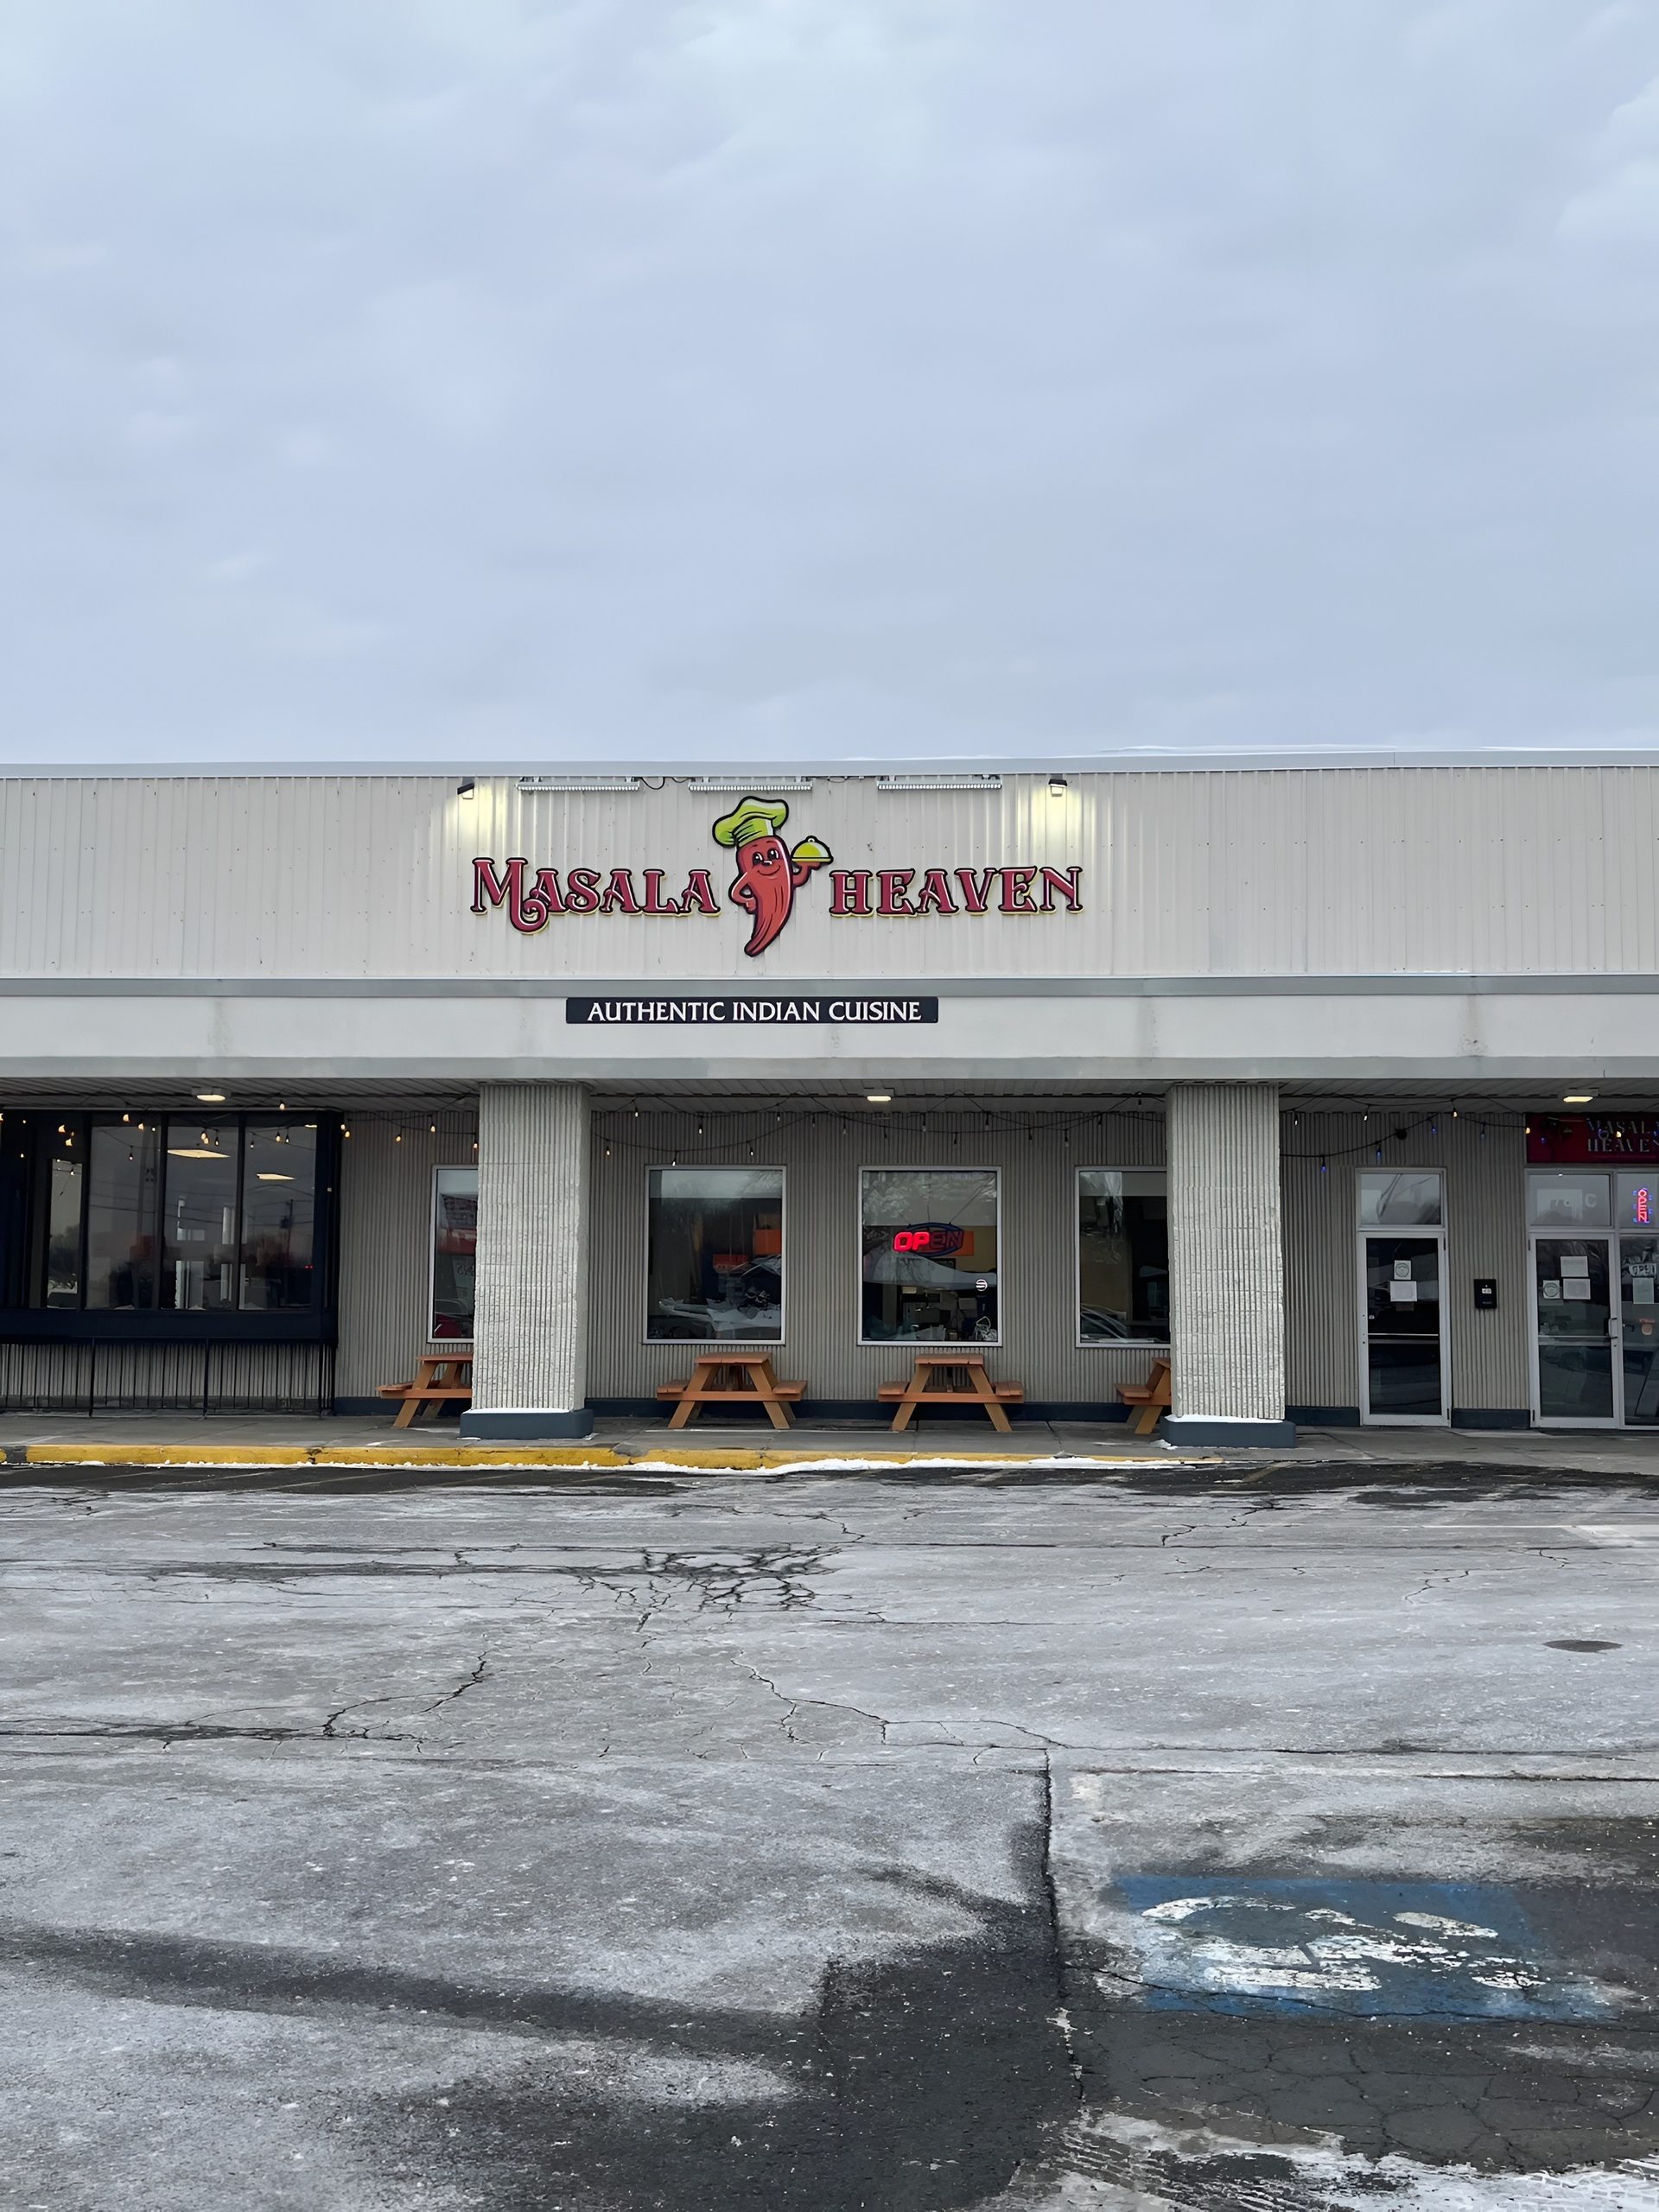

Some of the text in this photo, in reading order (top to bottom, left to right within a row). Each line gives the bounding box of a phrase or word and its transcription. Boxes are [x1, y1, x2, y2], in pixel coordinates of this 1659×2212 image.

[470, 857, 1084, 934] MASALA HEAVEN
[587, 1001, 922, 1021] AUTHENTIC INDIAN CUISINE
[893, 1230, 963, 1253] OPEN
